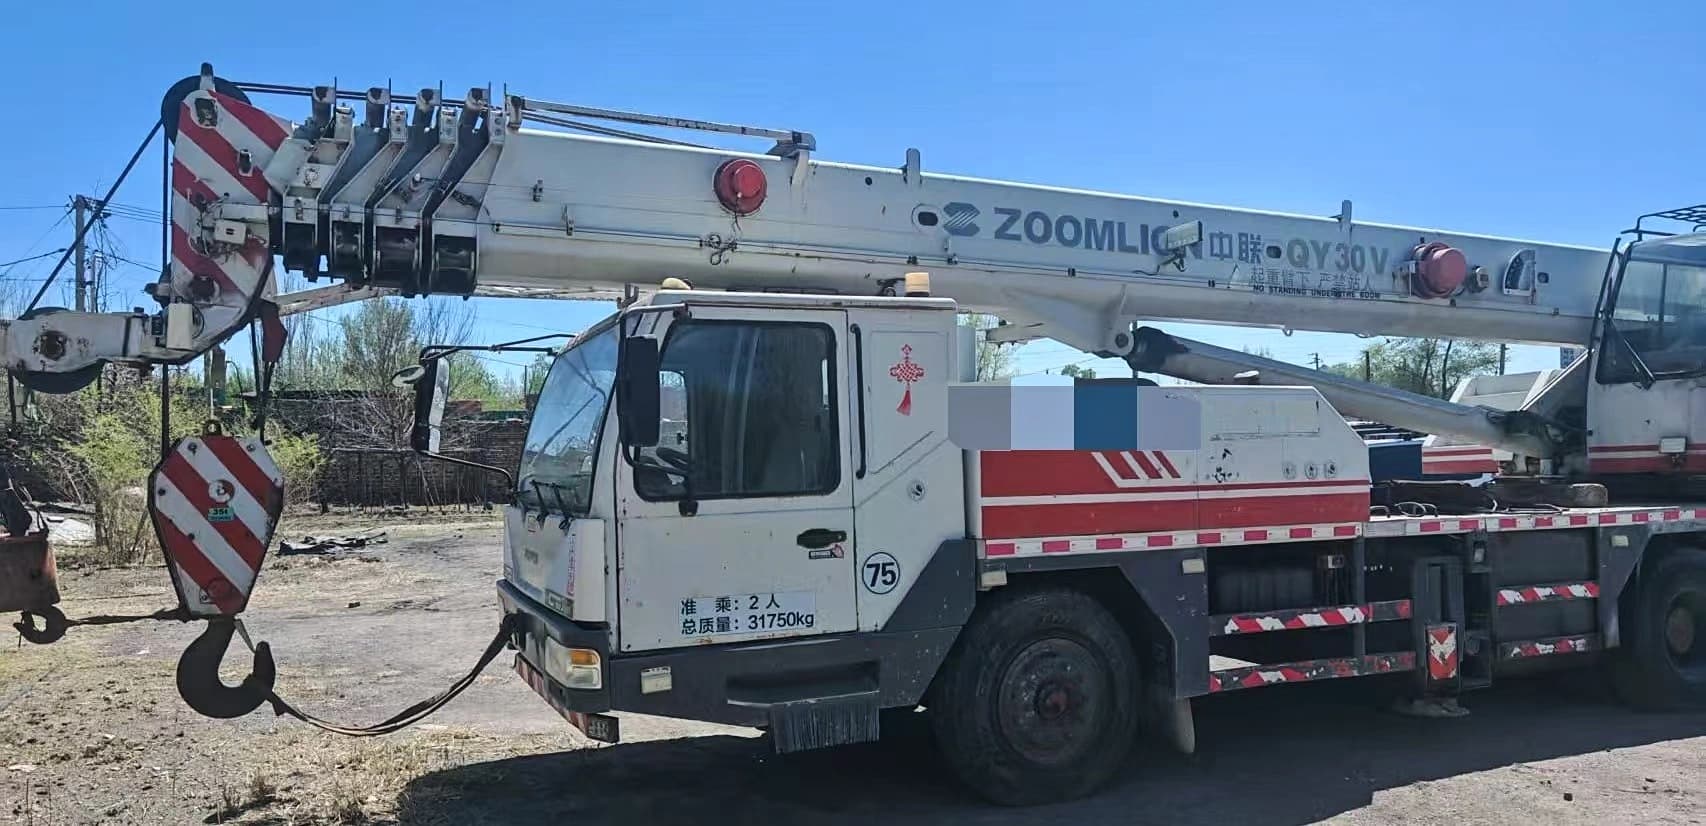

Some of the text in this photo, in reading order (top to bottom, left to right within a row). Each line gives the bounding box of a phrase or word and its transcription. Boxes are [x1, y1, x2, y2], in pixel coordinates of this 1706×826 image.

[1209, 231, 1262, 264] 中联
[1253, 284, 1265, 293] NO
[1269, 285, 1307, 296] STANDING
[866, 562, 896, 587] 75
[681, 598, 697, 615] 准
[749, 596, 759, 610] 2
[766, 593, 780, 609] 人
[748, 612, 814, 630] 31750kg
